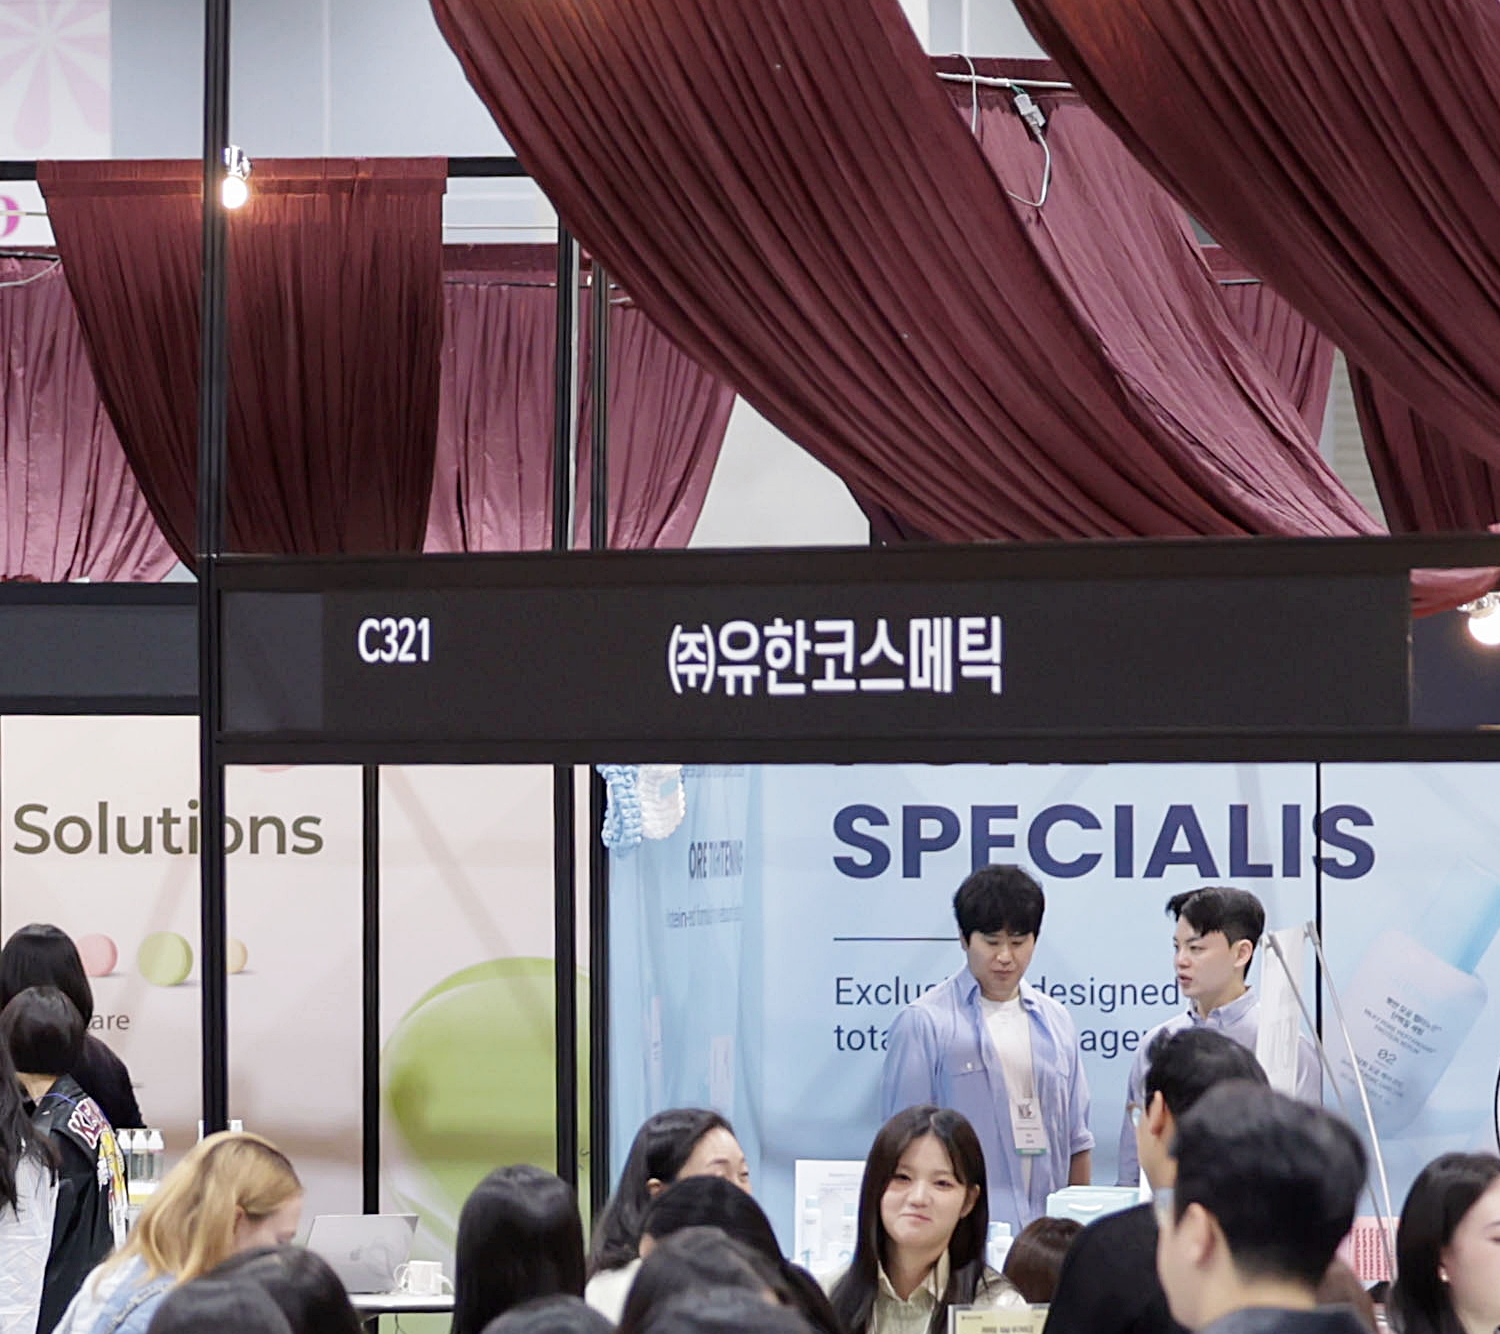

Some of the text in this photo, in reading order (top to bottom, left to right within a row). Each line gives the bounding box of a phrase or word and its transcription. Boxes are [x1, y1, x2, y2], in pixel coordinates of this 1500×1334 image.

[357, 617, 431, 663] C321
[13, 798, 325, 856] Solutions
[831, 803, 1376, 880] SPECIALIS
